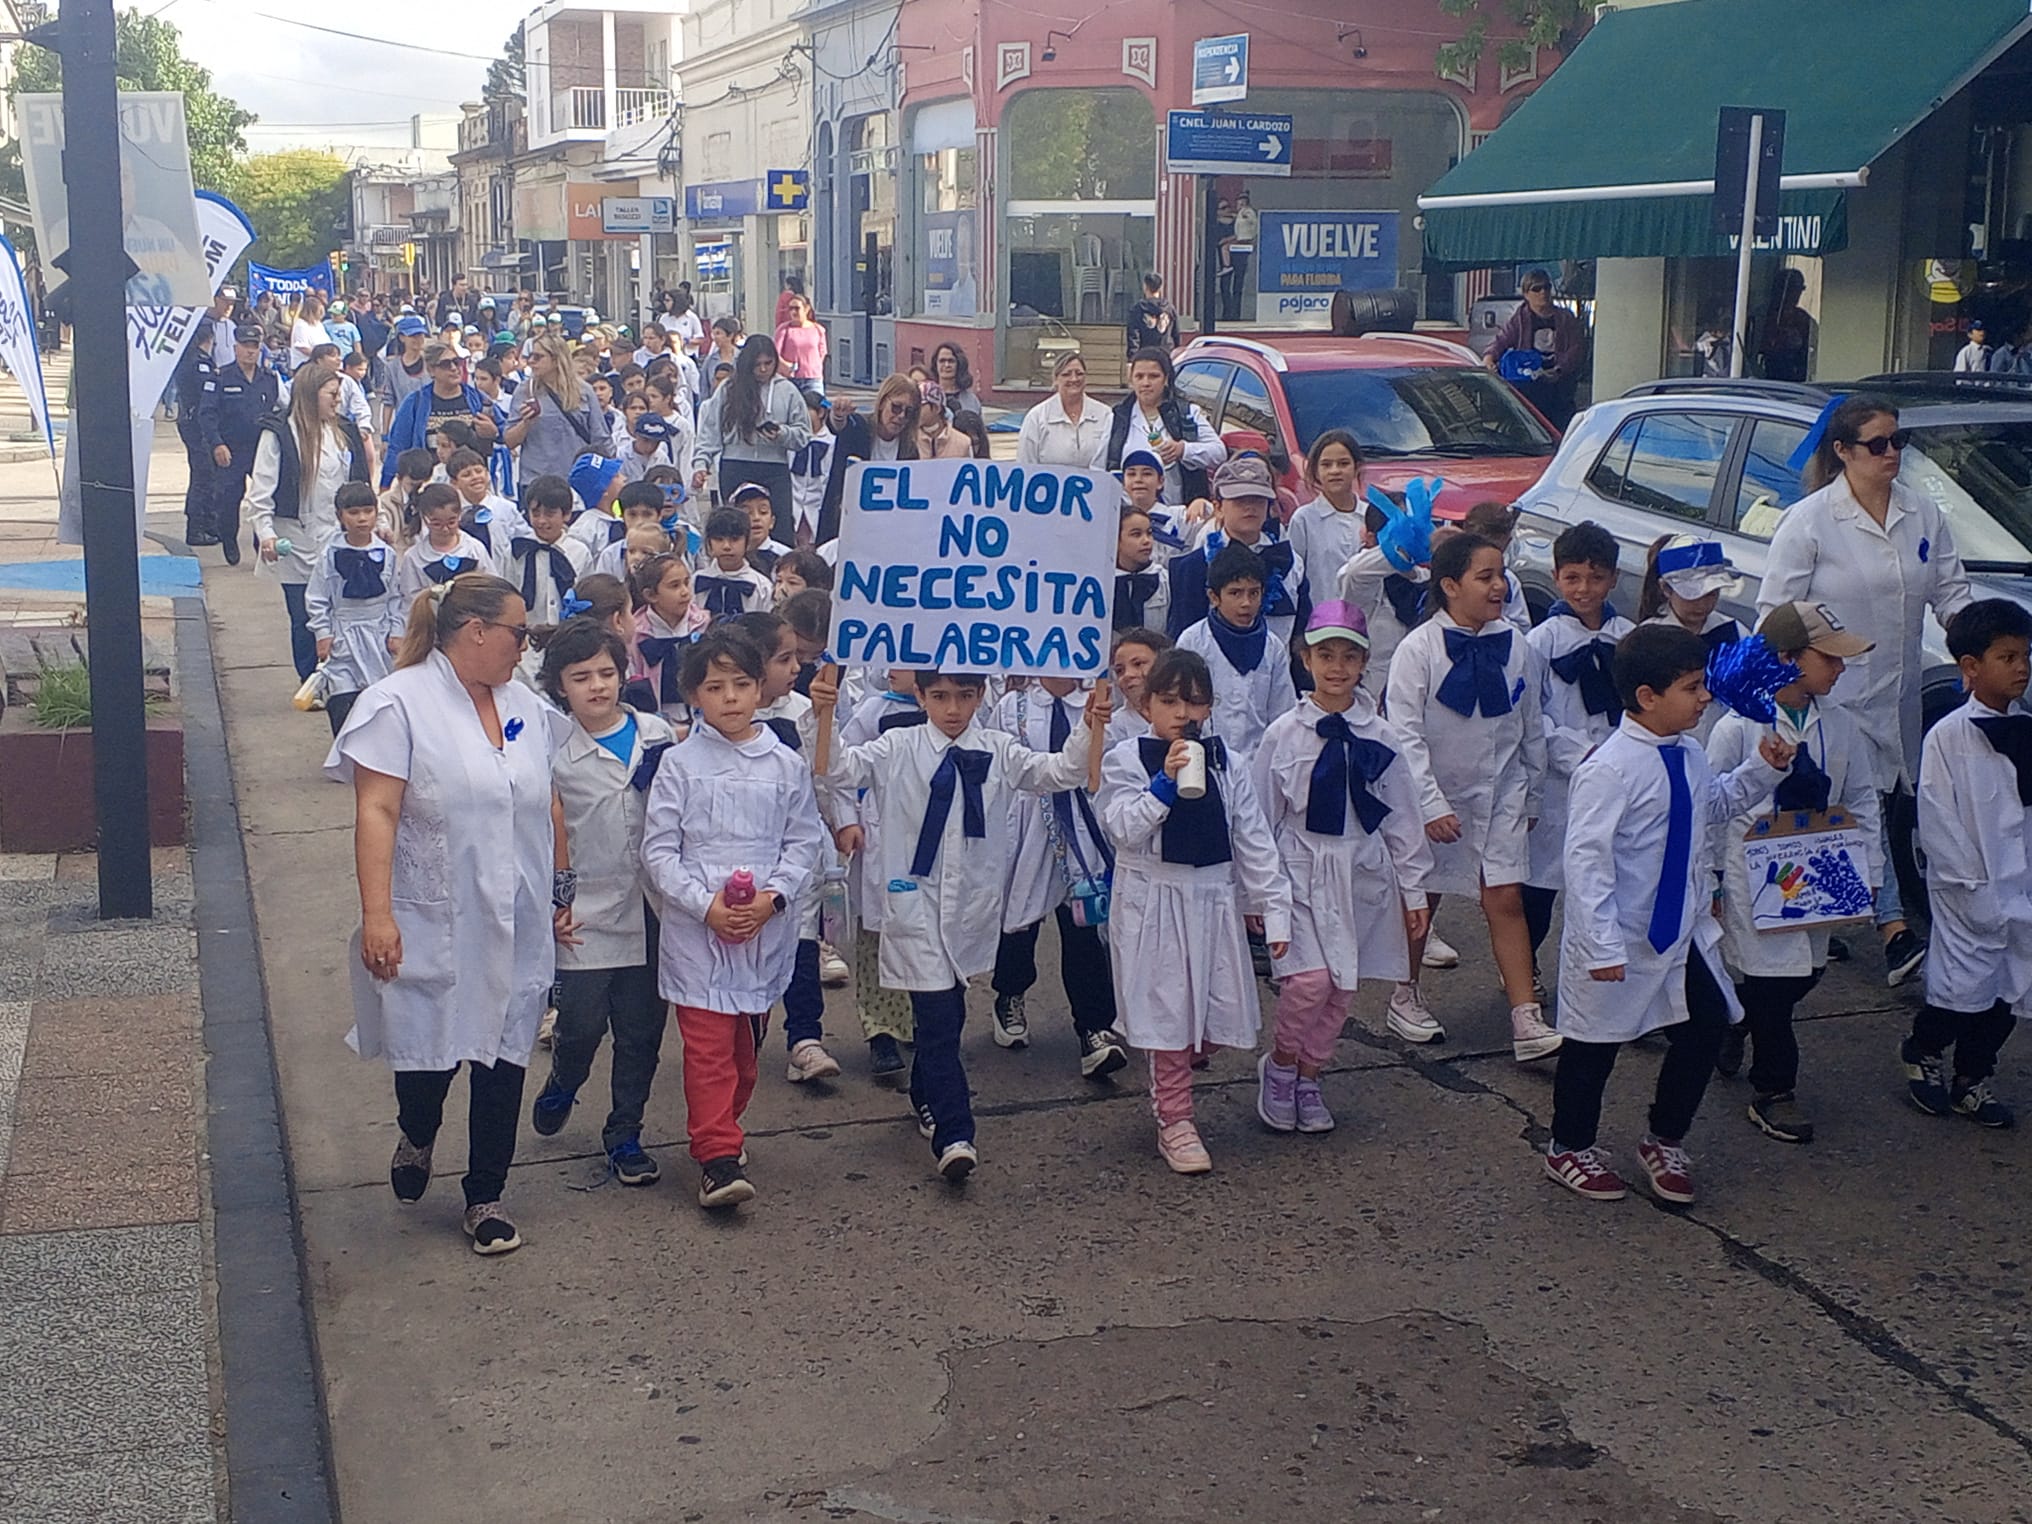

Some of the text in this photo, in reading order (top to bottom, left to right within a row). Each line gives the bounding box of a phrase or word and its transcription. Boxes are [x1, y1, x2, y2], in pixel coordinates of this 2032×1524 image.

[1210, 118, 1237, 129] JUAN
[1247, 120, 1291, 132] CARDOZO
[575, 203, 602, 218] LA
[1281, 223, 1380, 258] VUELVE
[1729, 215, 1821, 250] NTINO
[859, 463, 1093, 522] EL AMOR
[939, 513, 1009, 558] NO
[836, 618, 1101, 670] PALABRAS
